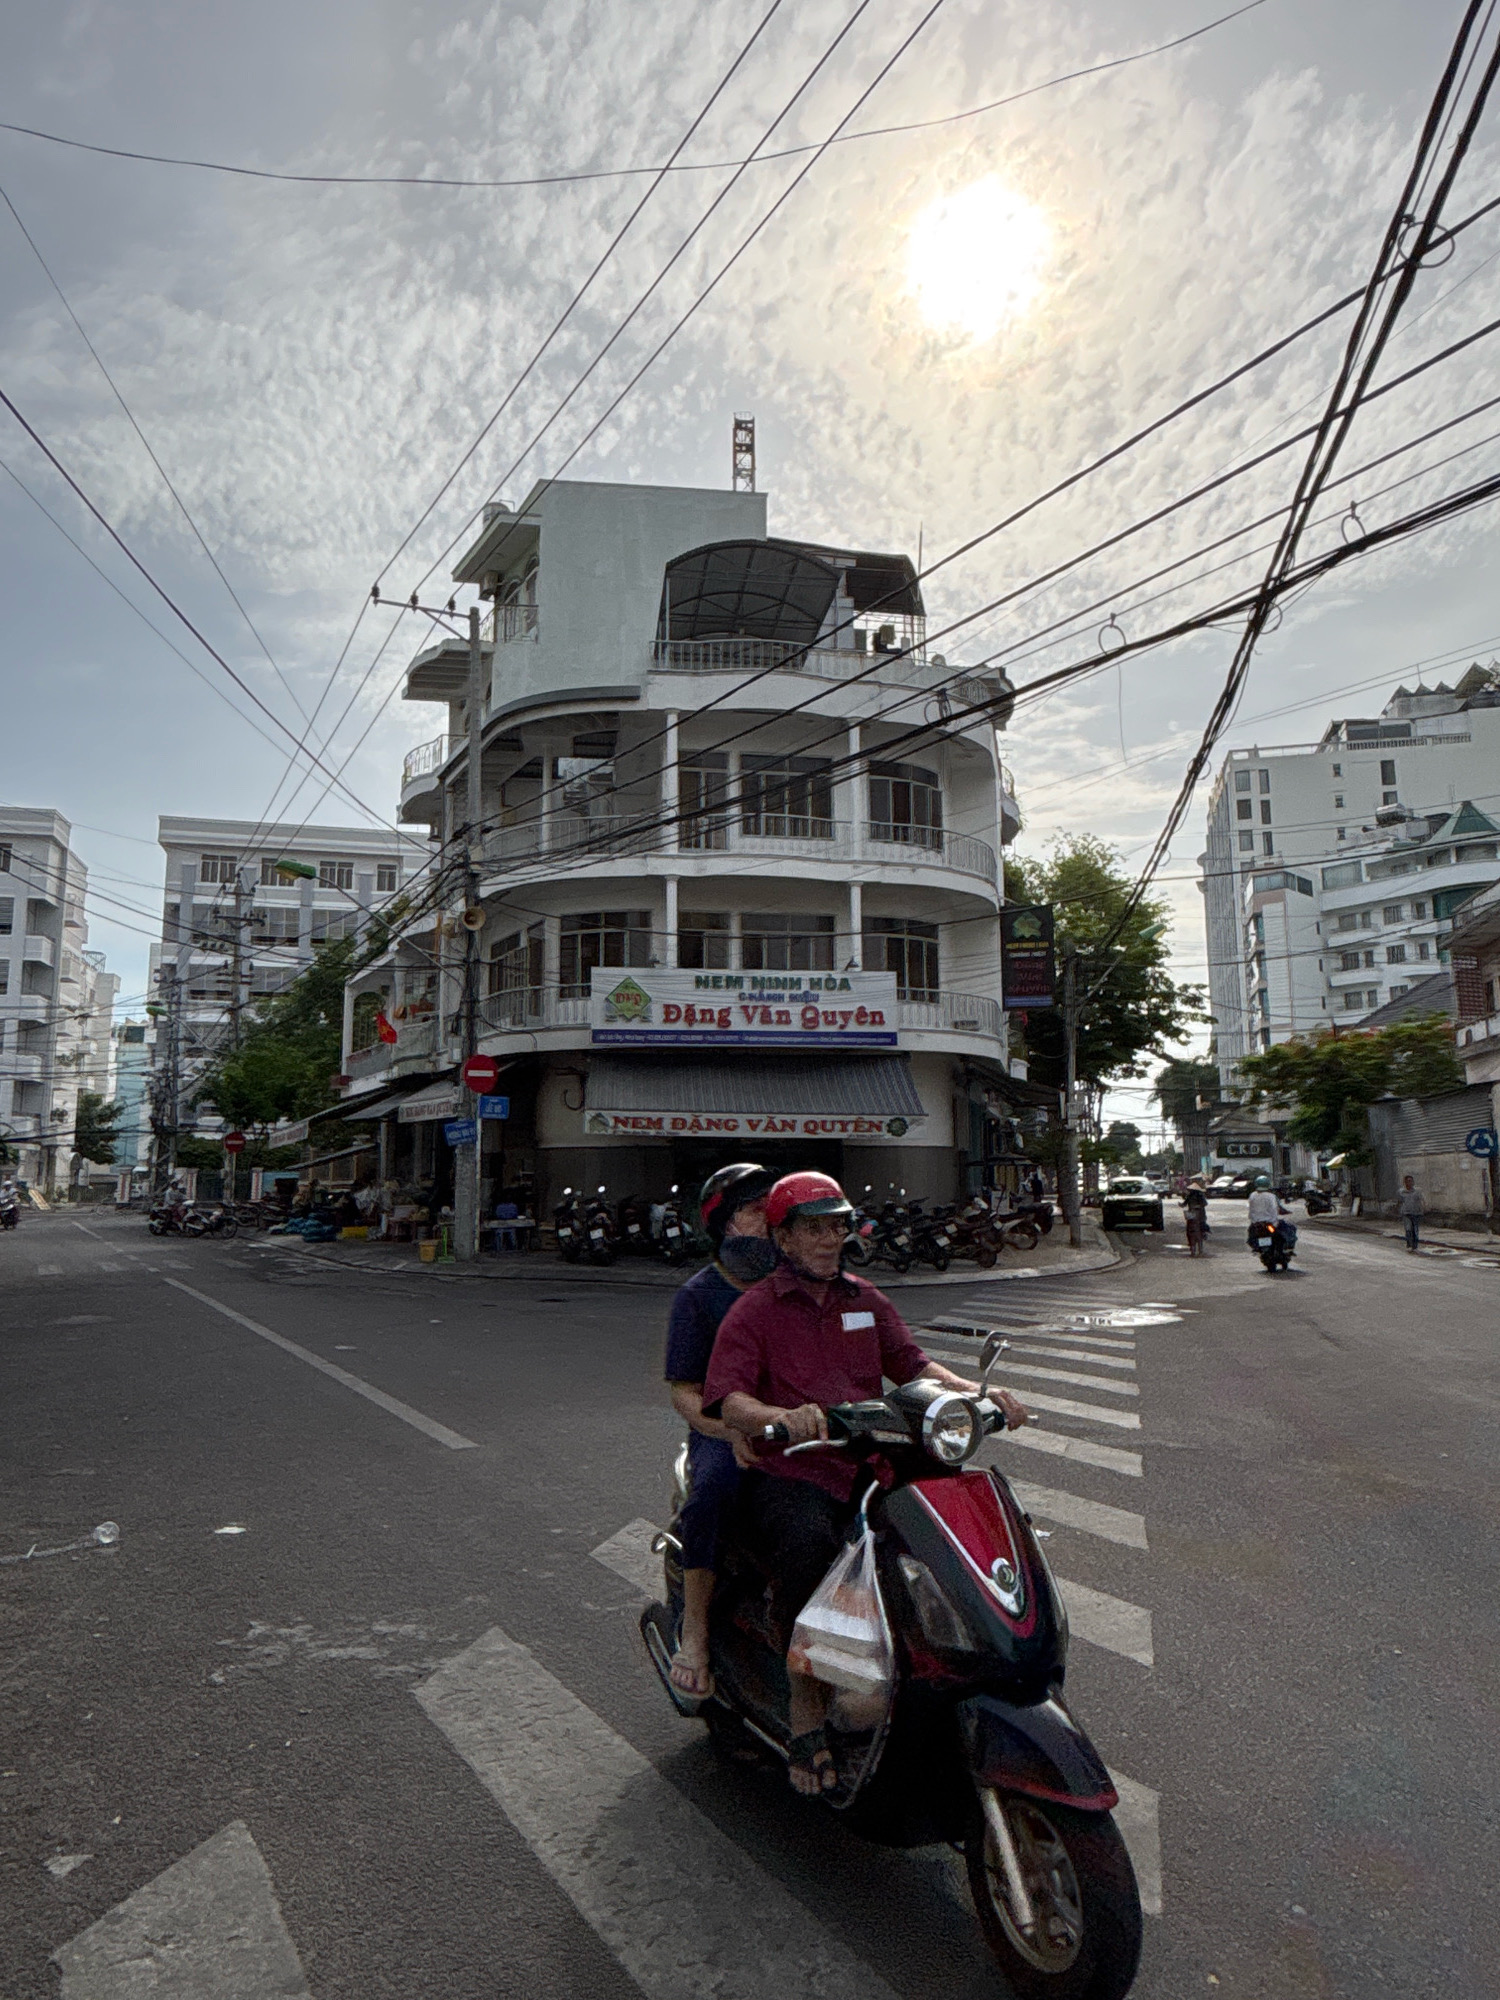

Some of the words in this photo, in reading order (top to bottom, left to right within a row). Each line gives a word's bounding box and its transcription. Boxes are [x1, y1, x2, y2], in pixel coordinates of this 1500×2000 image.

[695, 976, 744, 989] NEM
[751, 976, 802, 990] NINH
[662, 1003, 732, 1028] Đặng
[740, 1004, 792, 1025] Văn
[801, 1005, 886, 1030] Quyên
[613, 1116, 665, 1130] NEM
[671, 1114, 739, 1134] ĐẶNG
[746, 1116, 797, 1133] VĂN
[803, 1117, 884, 1135] QUYÊN
